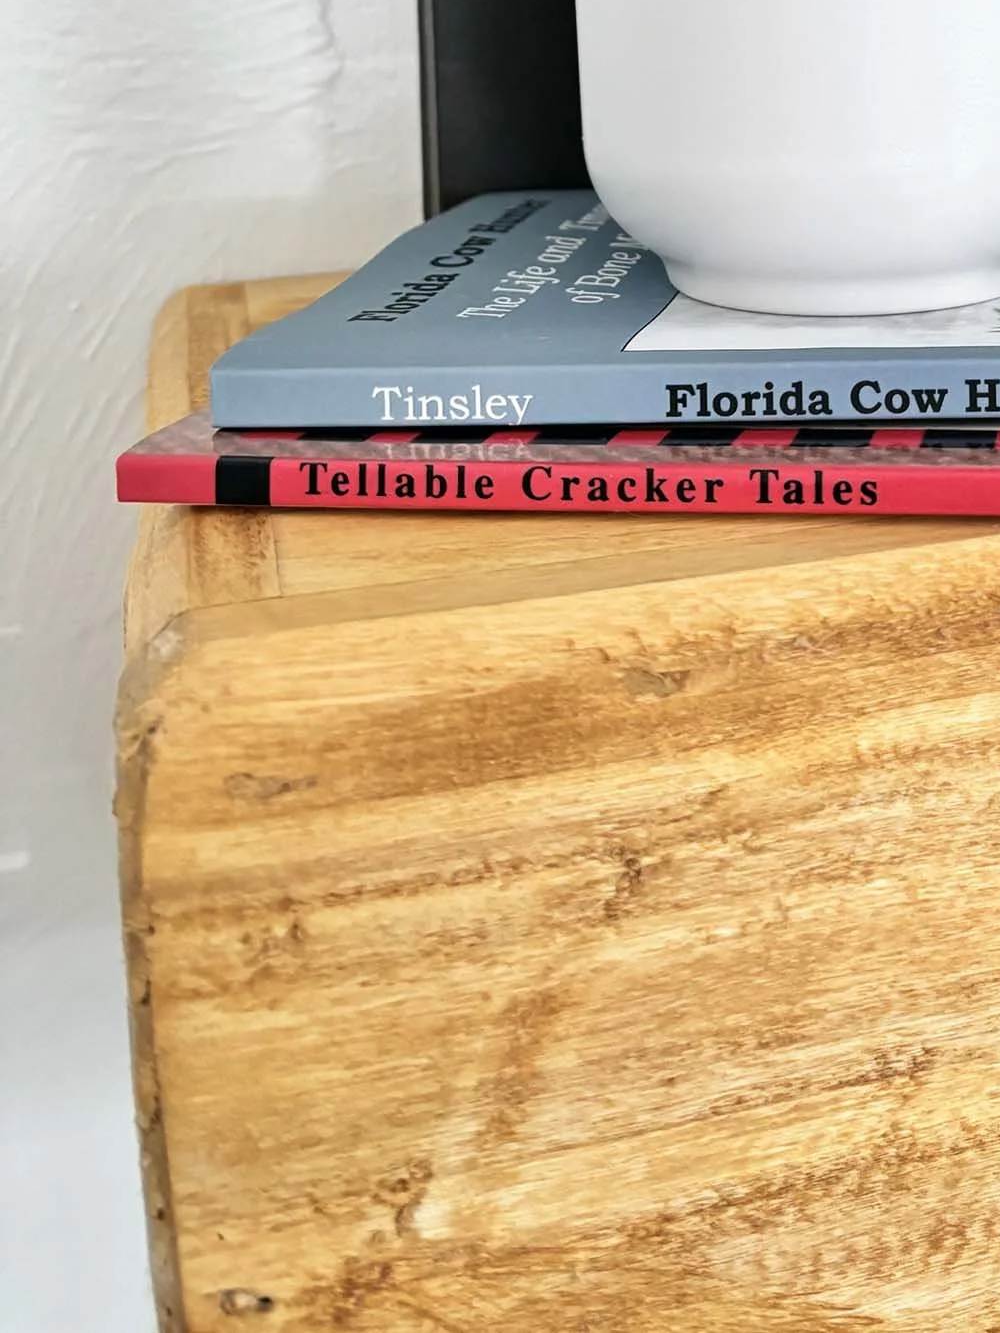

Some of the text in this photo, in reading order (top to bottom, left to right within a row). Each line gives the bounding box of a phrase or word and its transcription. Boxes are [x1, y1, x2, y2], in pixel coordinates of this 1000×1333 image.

[347, 273, 460, 322] Florida
[429, 235, 497, 268] Cow
[455, 296, 526, 318] The
[491, 269, 560, 295] Life
[537, 235, 588, 264] and
[573, 251, 642, 288] Bone
[564, 286, 621, 304] of
[371, 384, 534, 426] Tinsley
[665, 380, 833, 418] Florida
[850, 379, 949, 415] Cow
[300, 462, 879, 506] Tellable Cracker Tales
